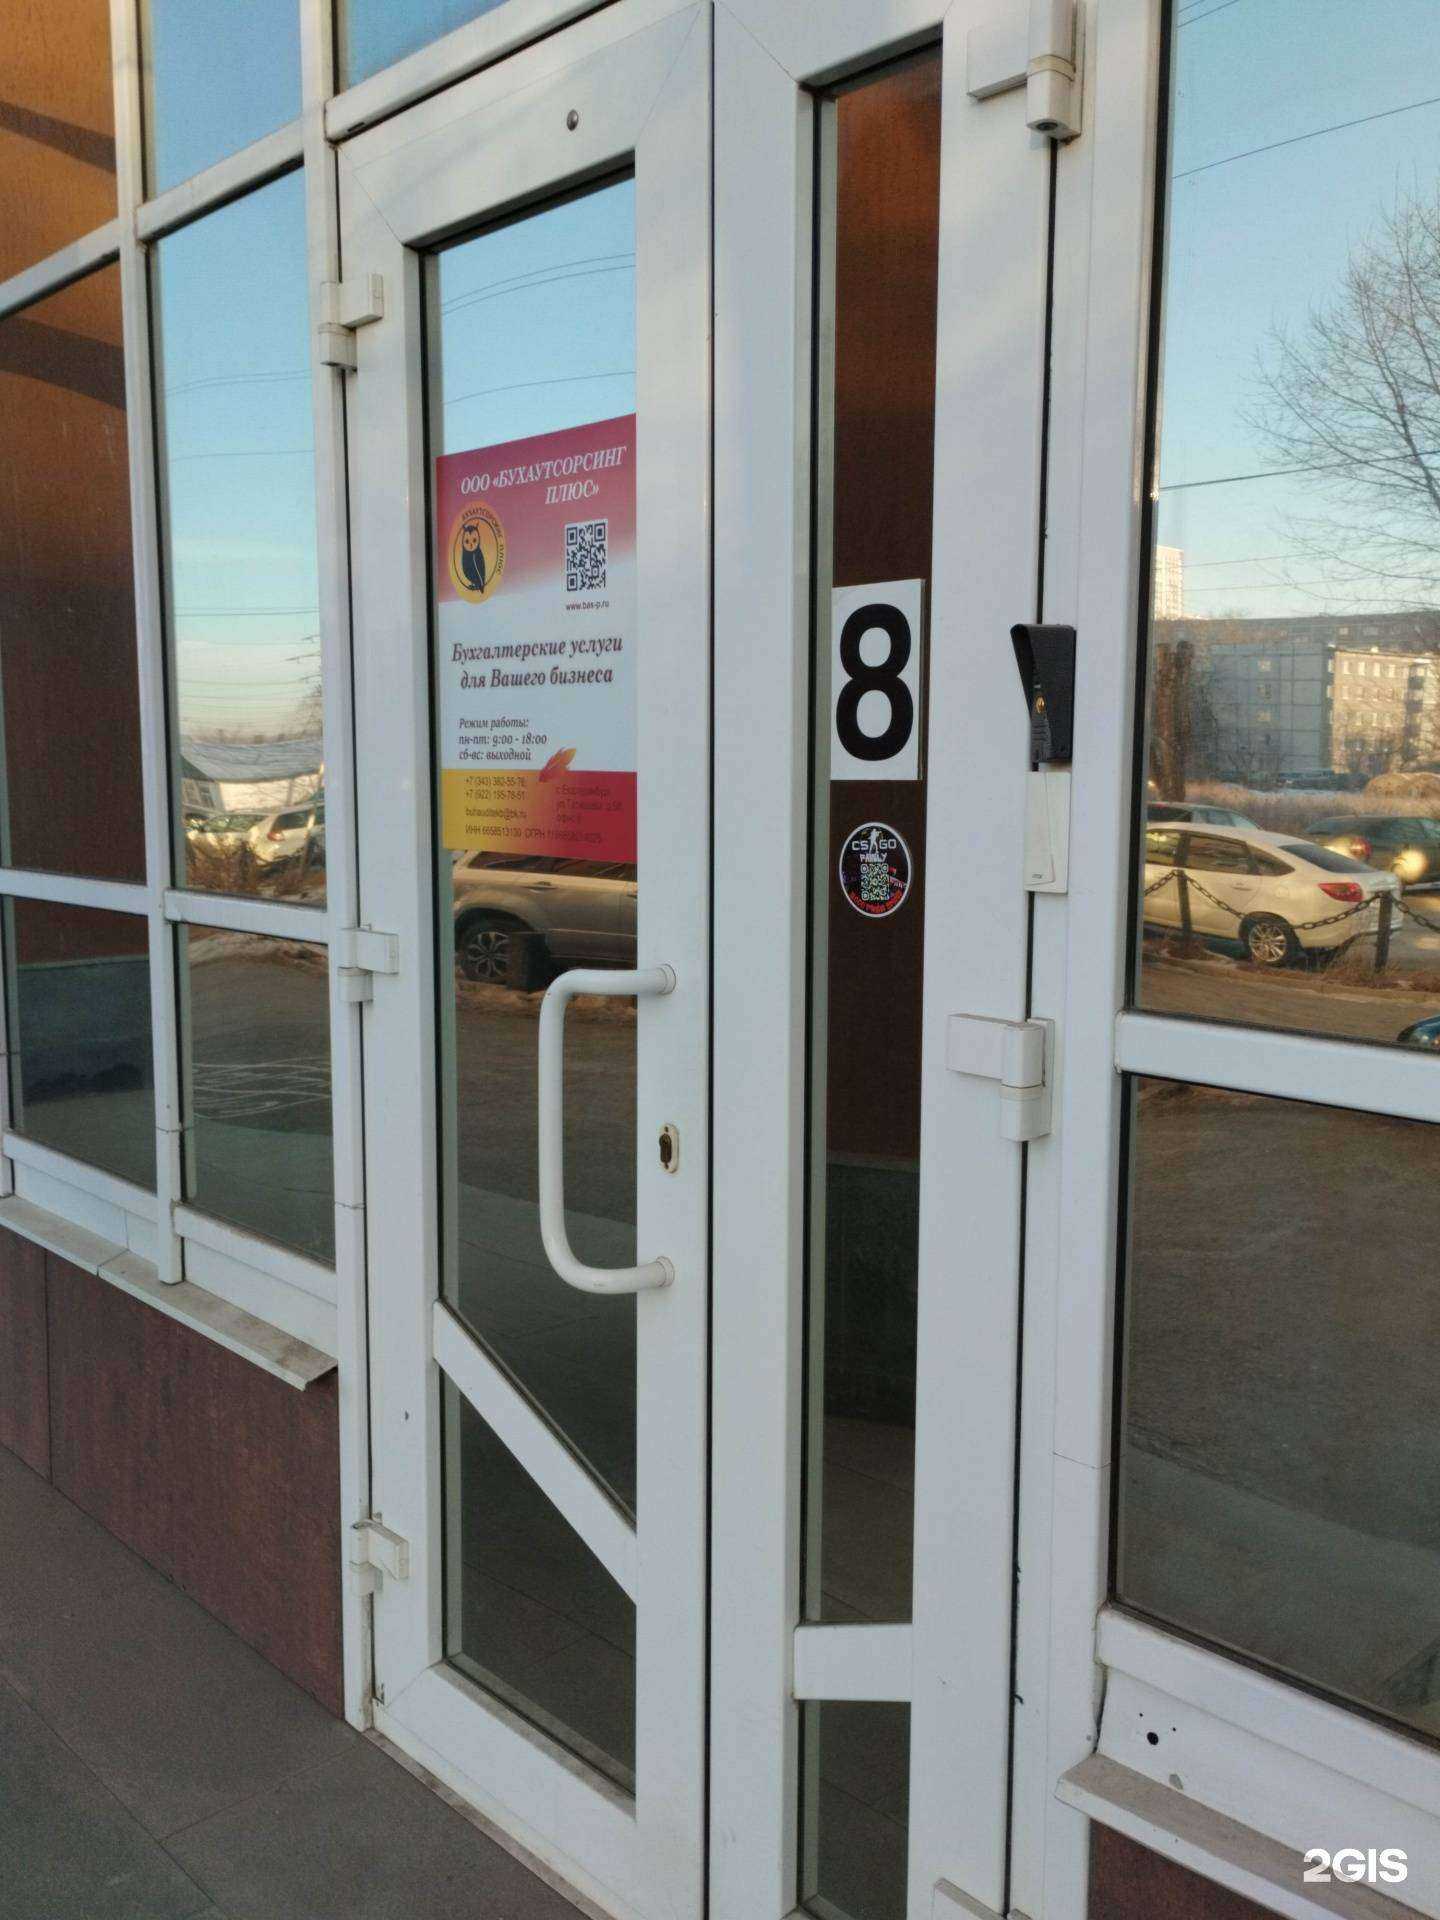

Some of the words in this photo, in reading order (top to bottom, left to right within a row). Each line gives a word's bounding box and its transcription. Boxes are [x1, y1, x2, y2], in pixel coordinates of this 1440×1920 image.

[461, 473, 490, 494] ООО
[492, 446, 627, 488] «БУХАУТСОРСИНГ
[544, 479, 600, 504] ПЛЮС»
[565, 600, 610, 611] www.bas-p.ru
[452, 640, 567, 664] Бухгалтерские
[568, 637, 624, 658] услуги
[460, 671, 486, 690] для
[490, 668, 546, 688] Вашего
[549, 666, 613, 685] бизнеса
[836, 603, 913, 761] 8
[459, 718, 488, 729] Режим
[490, 716, 529, 731] работы:
[458, 736, 490, 745] пн-пт:
[492, 735, 513, 747] 9:00
[521, 733, 547, 745] 18:00
[459, 748, 485, 760] сб-вс:
[486, 748, 532, 761] выходной
[852, 840, 869, 851] CS
[879, 839, 897, 849] GO
